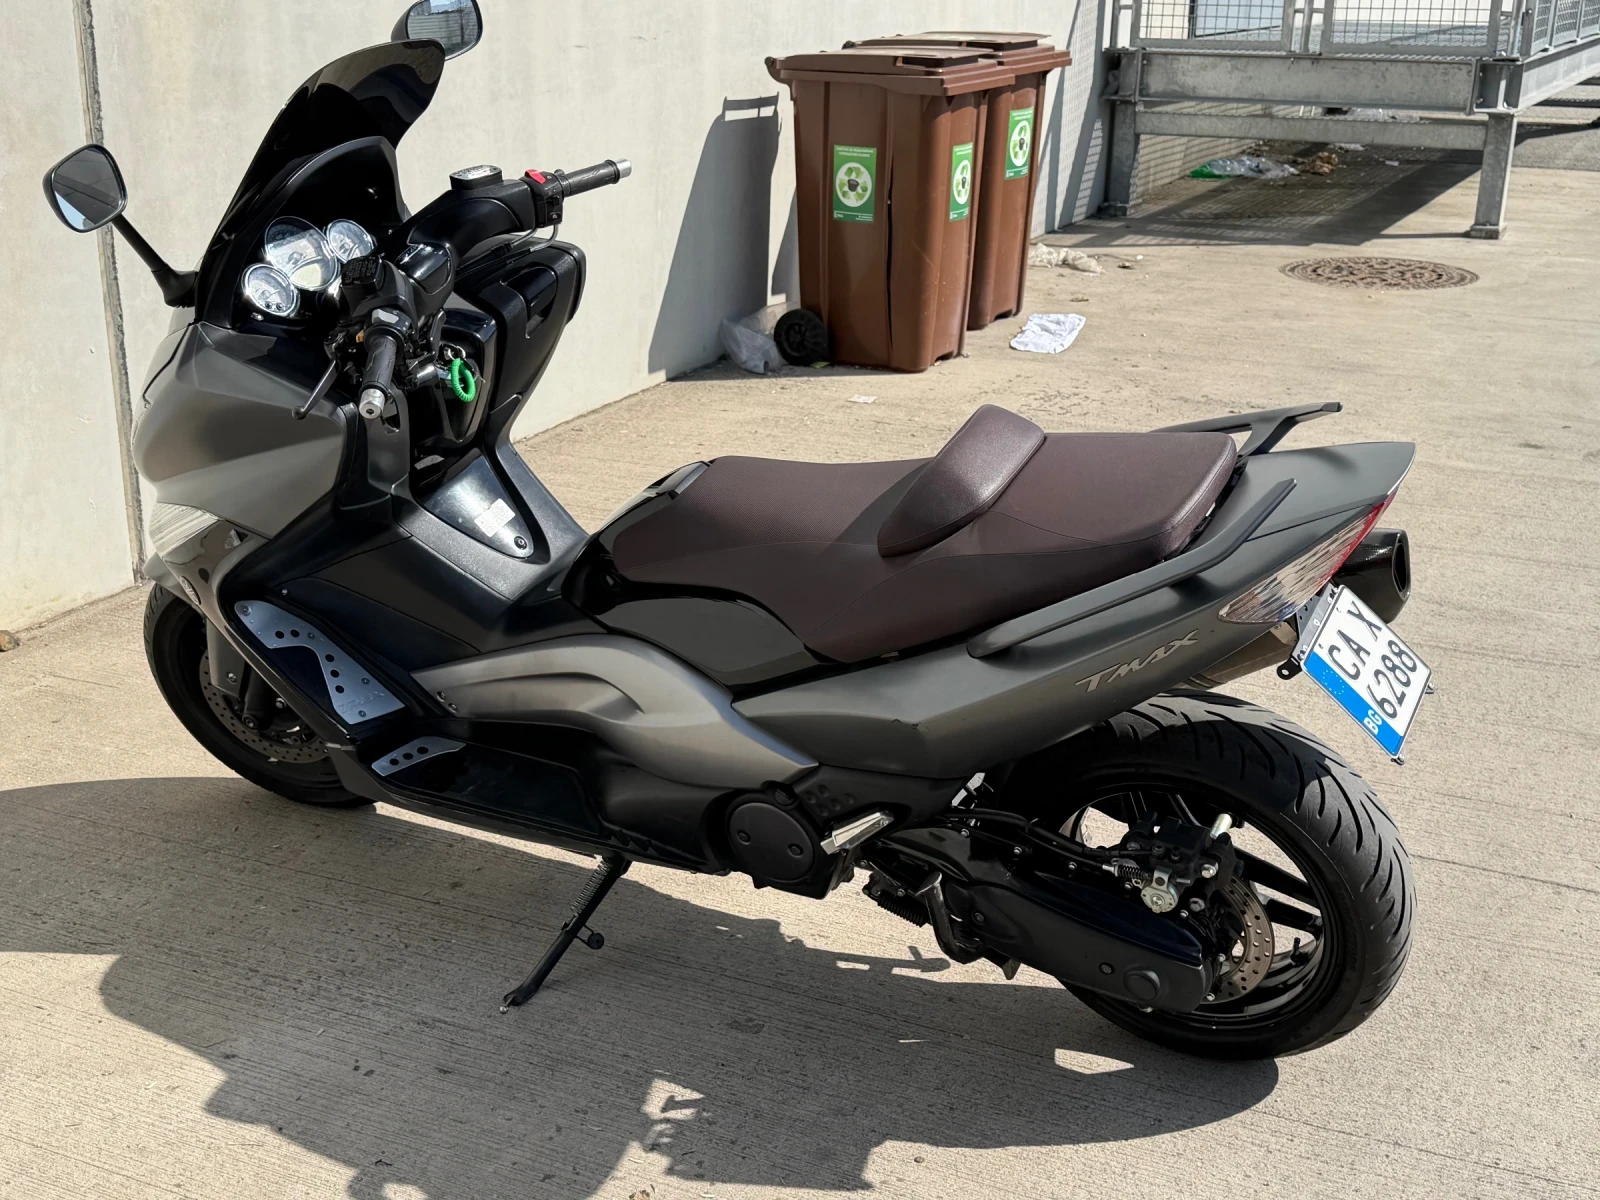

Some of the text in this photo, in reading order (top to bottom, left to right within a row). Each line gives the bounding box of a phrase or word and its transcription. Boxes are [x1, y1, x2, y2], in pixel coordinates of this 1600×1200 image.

[1074, 628, 1199, 693] TMAX
[1328, 600, 1382, 681] CA X
[1366, 639, 1418, 720] 6288
[1362, 708, 1383, 735] BG
